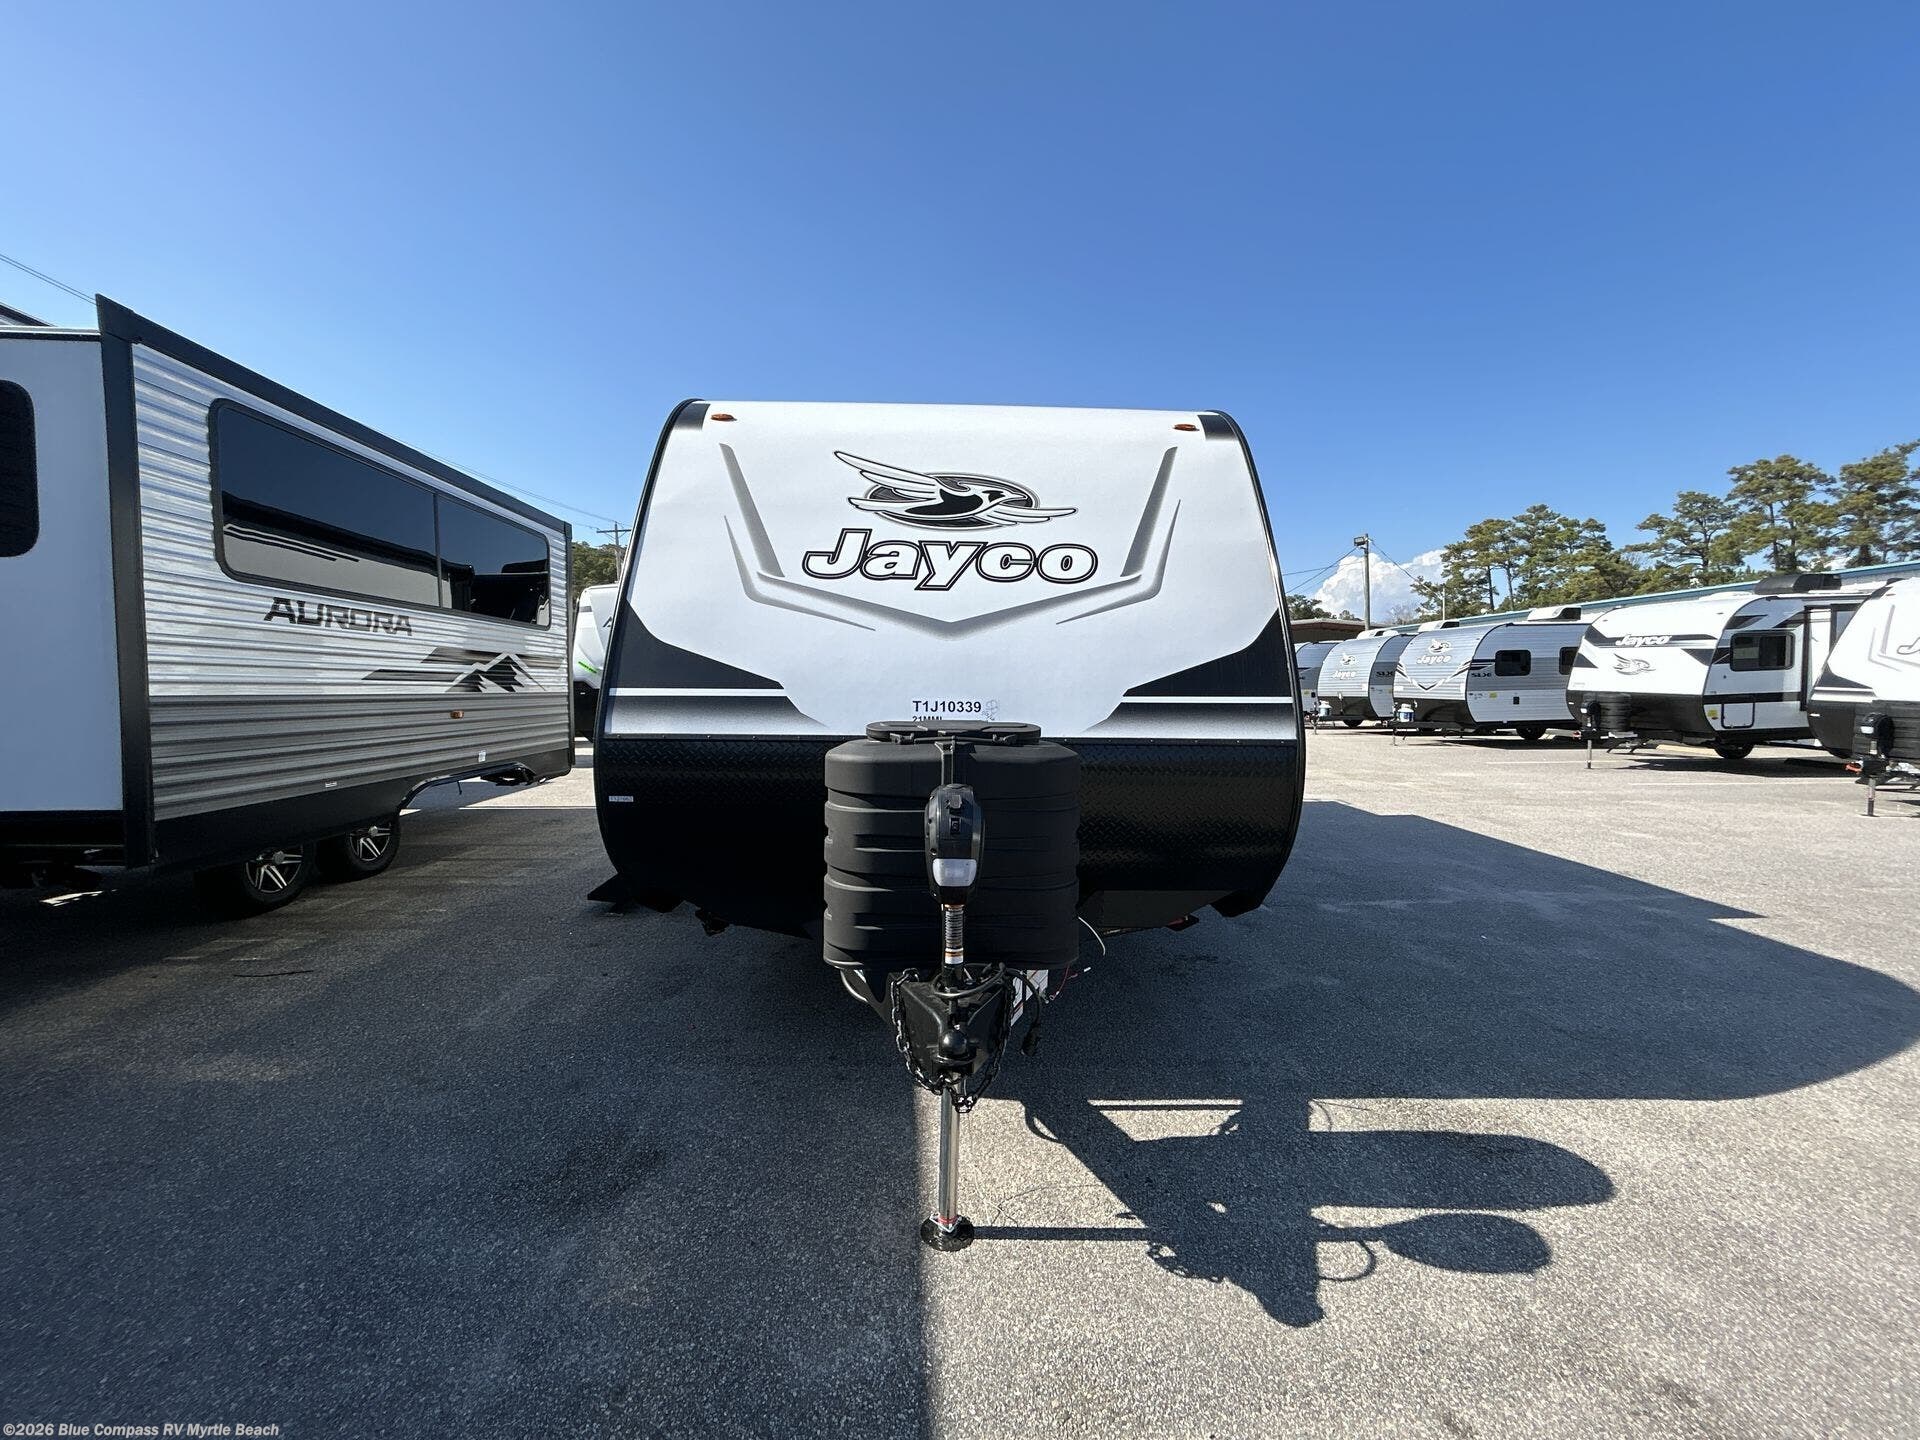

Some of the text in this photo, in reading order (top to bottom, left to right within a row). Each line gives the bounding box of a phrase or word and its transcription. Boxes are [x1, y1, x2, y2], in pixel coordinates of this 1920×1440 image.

[802, 528, 1098, 591] Jayco
[264, 597, 412, 636] AURORA
[1615, 633, 1672, 648] Jayco
[1416, 655, 1452, 665] Jayco
[912, 700, 982, 713] T1J10339
